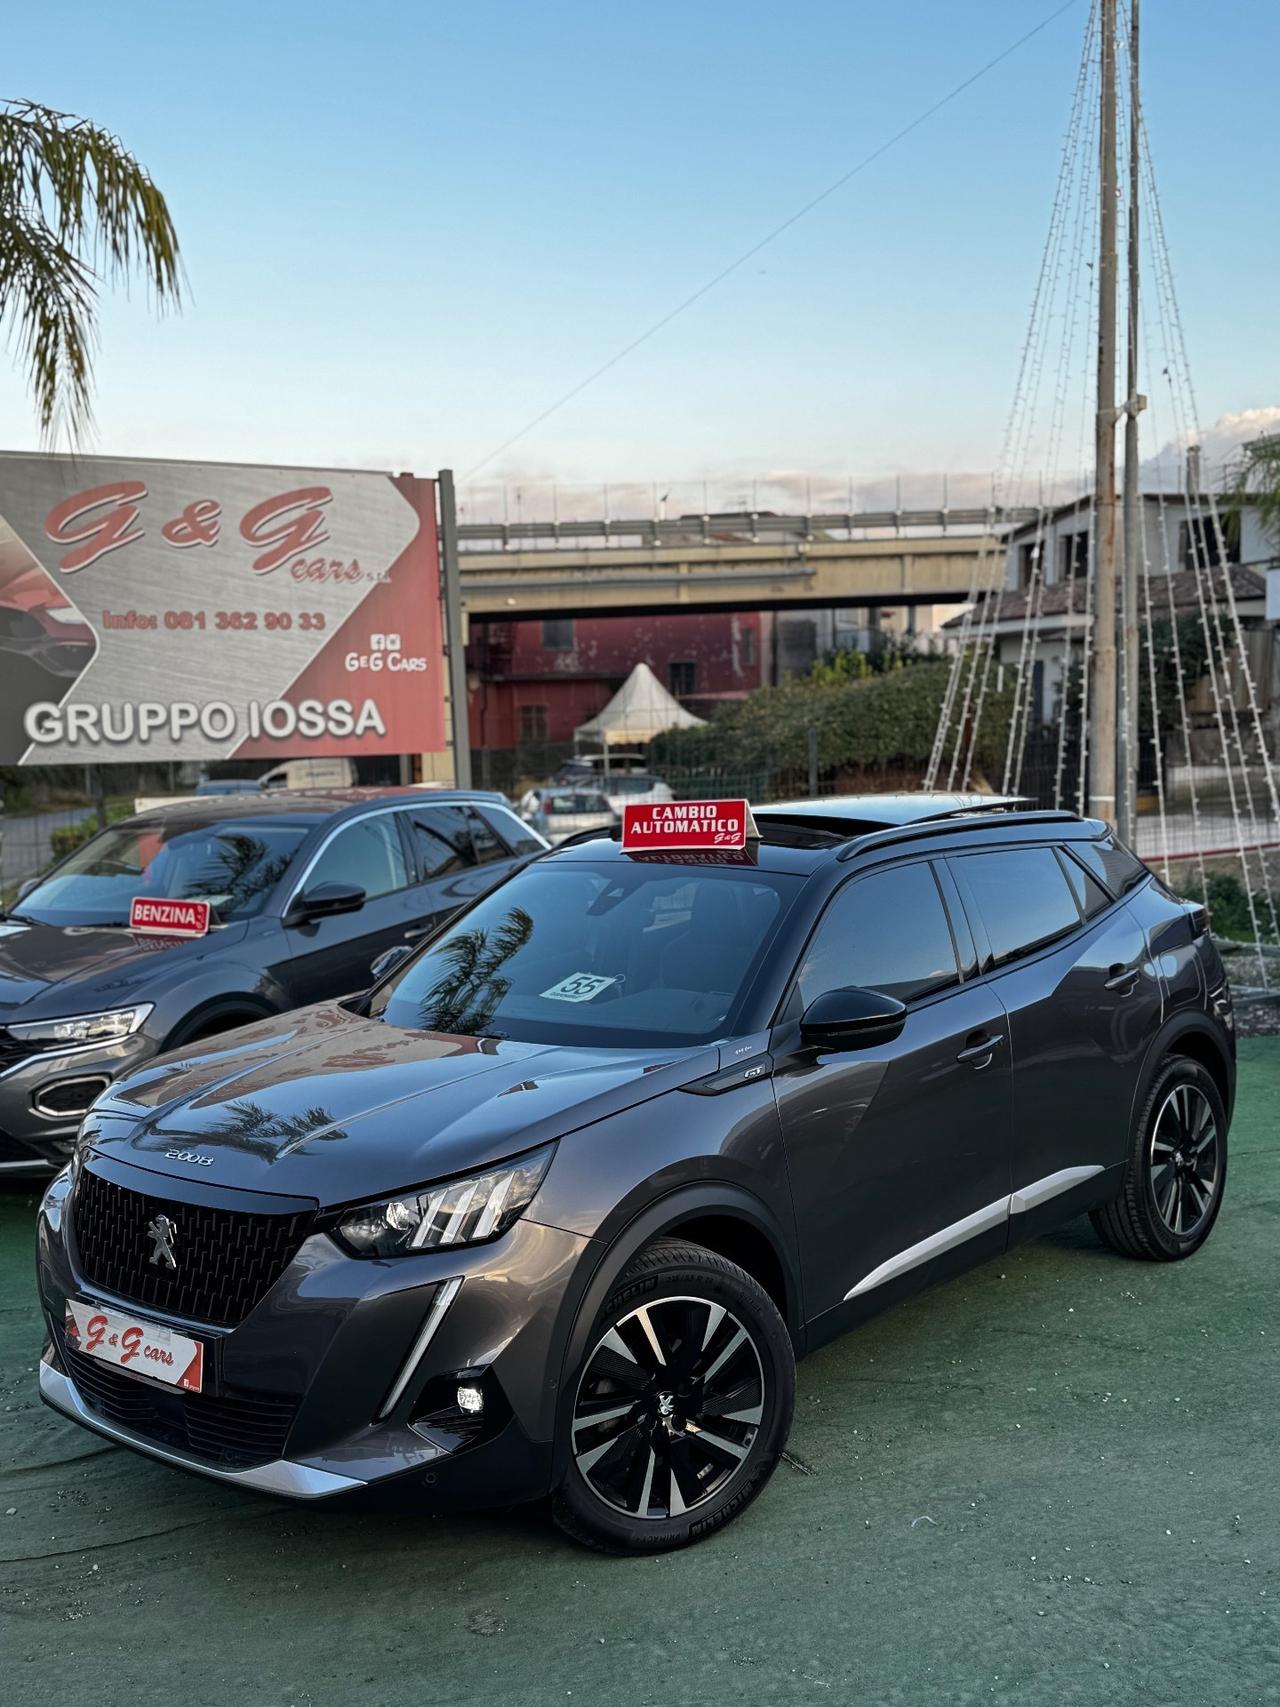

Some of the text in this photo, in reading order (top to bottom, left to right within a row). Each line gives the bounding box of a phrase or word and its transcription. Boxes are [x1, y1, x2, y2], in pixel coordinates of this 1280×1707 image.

[45, 480, 333, 574] G & G
[290, 557, 363, 584] cars
[102, 609, 158, 630] Info:
[164, 611, 206, 630] 081
[264, 611, 292, 631] 90
[298, 612, 326, 631] 33
[23, 698, 387, 743] GRUPPO IOSSA
[652, 805, 718, 820] CAMBIO
[630, 819, 739, 834] AUTOMATICO
[134, 904, 196, 925] BENZINA
[560, 976, 606, 995] 55
[86, 1315, 174, 1366] G & G cars
[690, 1481, 754, 1537] MICHELIN
